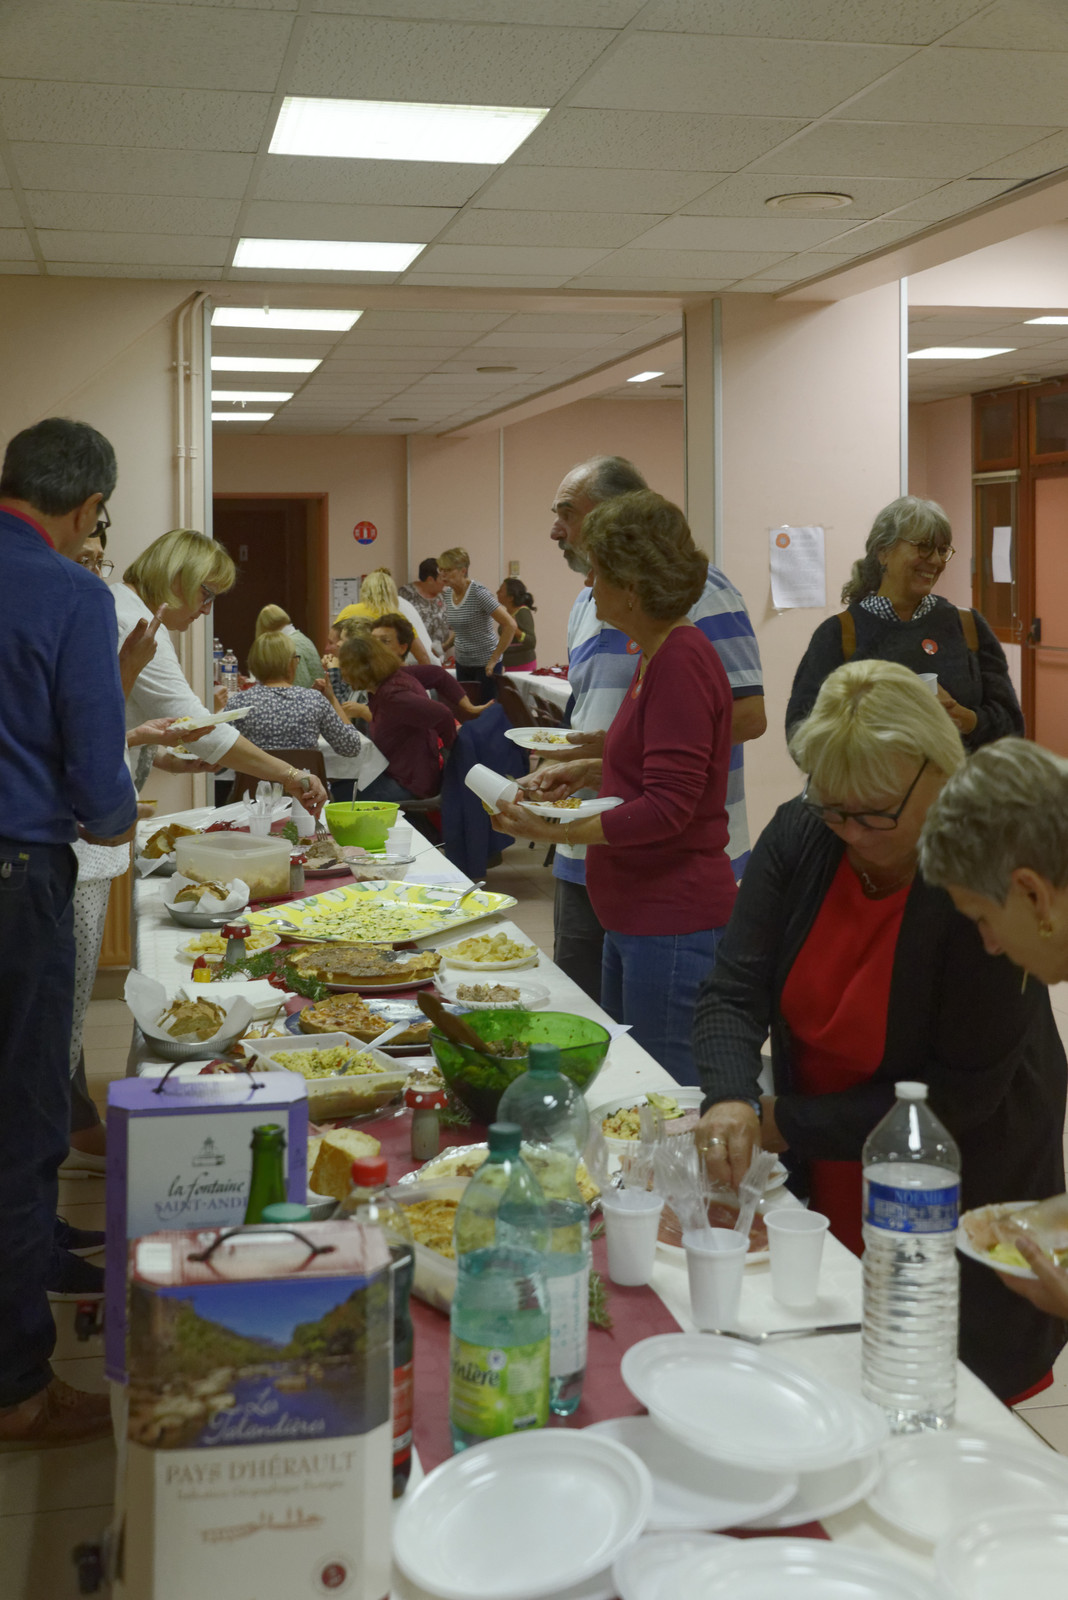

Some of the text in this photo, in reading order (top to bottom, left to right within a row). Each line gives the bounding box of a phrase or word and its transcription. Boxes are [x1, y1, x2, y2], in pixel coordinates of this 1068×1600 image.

[168, 1175, 245, 1206] la fontaine
[166, 1462, 223, 1485] PAYS
